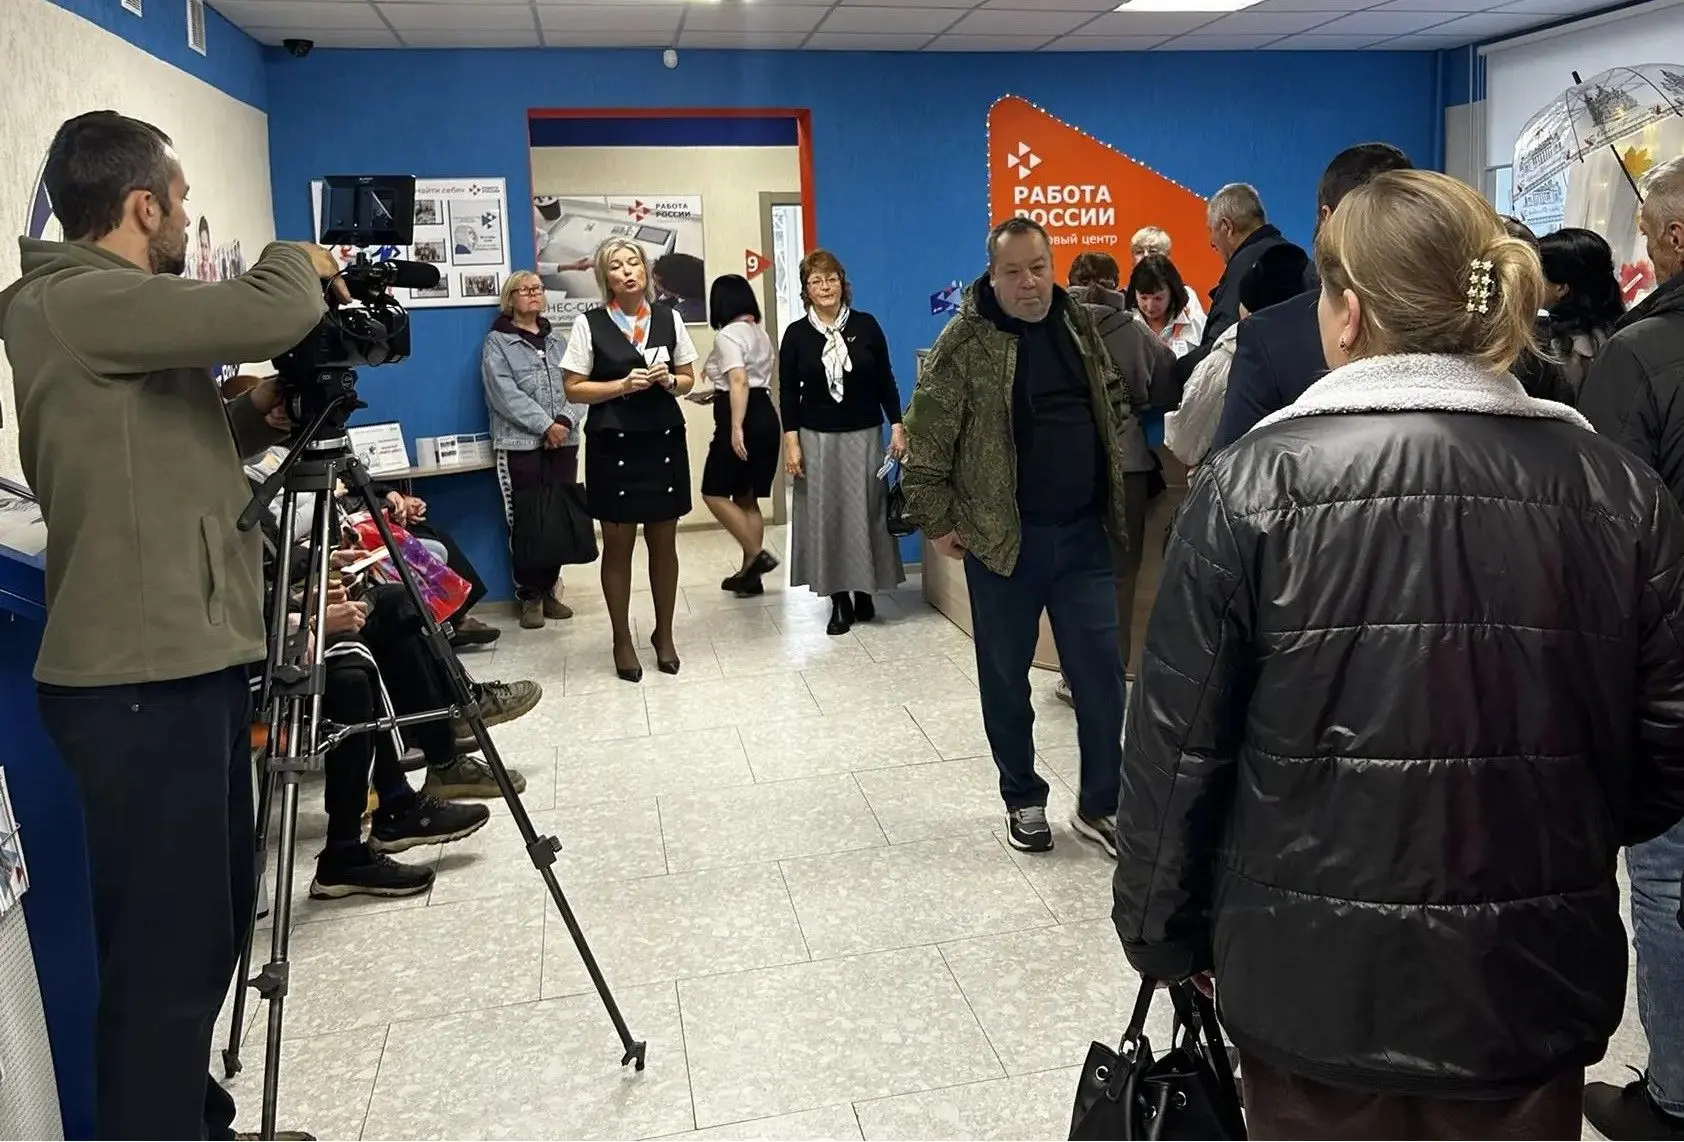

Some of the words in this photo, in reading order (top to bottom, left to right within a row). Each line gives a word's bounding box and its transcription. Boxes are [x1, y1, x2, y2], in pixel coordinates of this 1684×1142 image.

[1014, 185, 1112, 205] РАБОТА
[1049, 233, 1078, 246] овый
[1081, 234, 1118, 246] центр
[747, 255, 759, 273] 9
